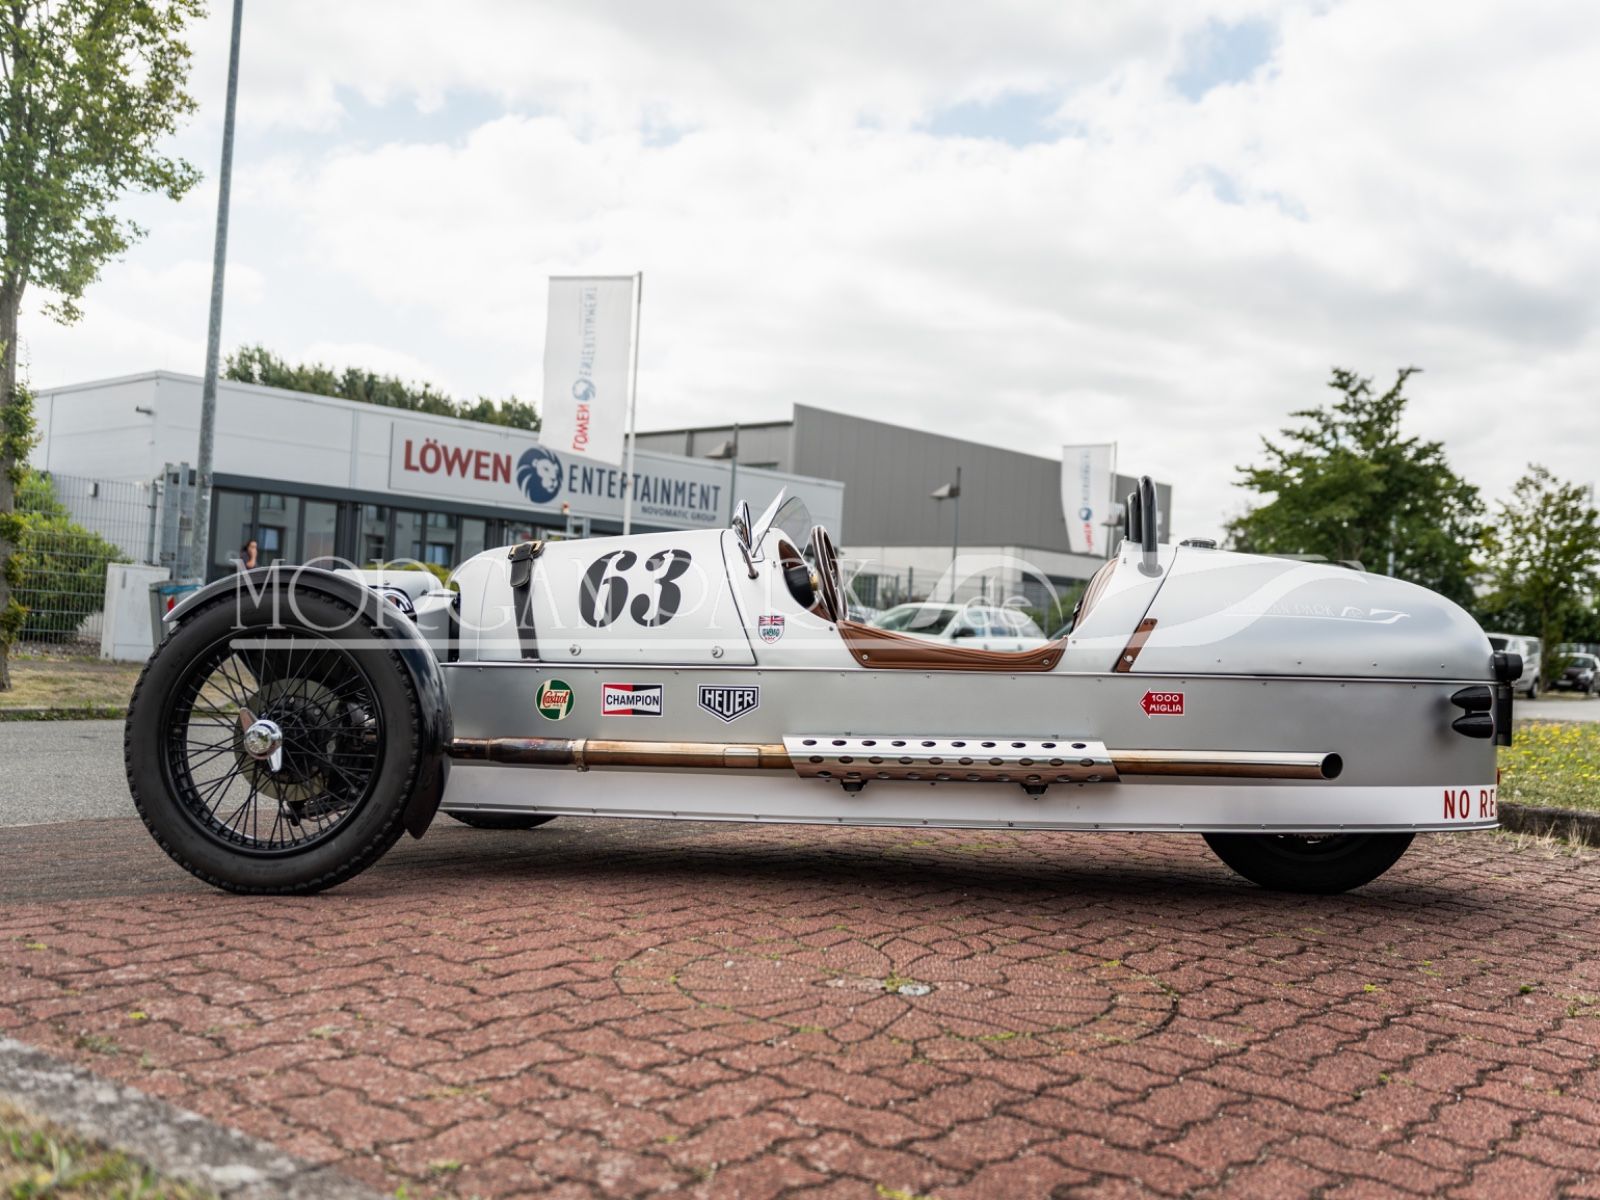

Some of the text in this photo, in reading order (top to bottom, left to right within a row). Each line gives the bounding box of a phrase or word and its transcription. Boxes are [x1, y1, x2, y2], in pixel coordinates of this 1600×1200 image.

[403, 437, 511, 484] LÖWEN
[641, 505, 717, 522] NOVOMATIC GROUP
[579, 549, 692, 627] 63
[542, 690, 569, 708] Castrol
[606, 694, 660, 706] CHAMPION
[704, 690, 754, 716] HEUER
[1151, 694, 1180, 702] 1000
[1149, 704, 1182, 712] MIGLIA
[1444, 788, 1498, 819] NO RE
